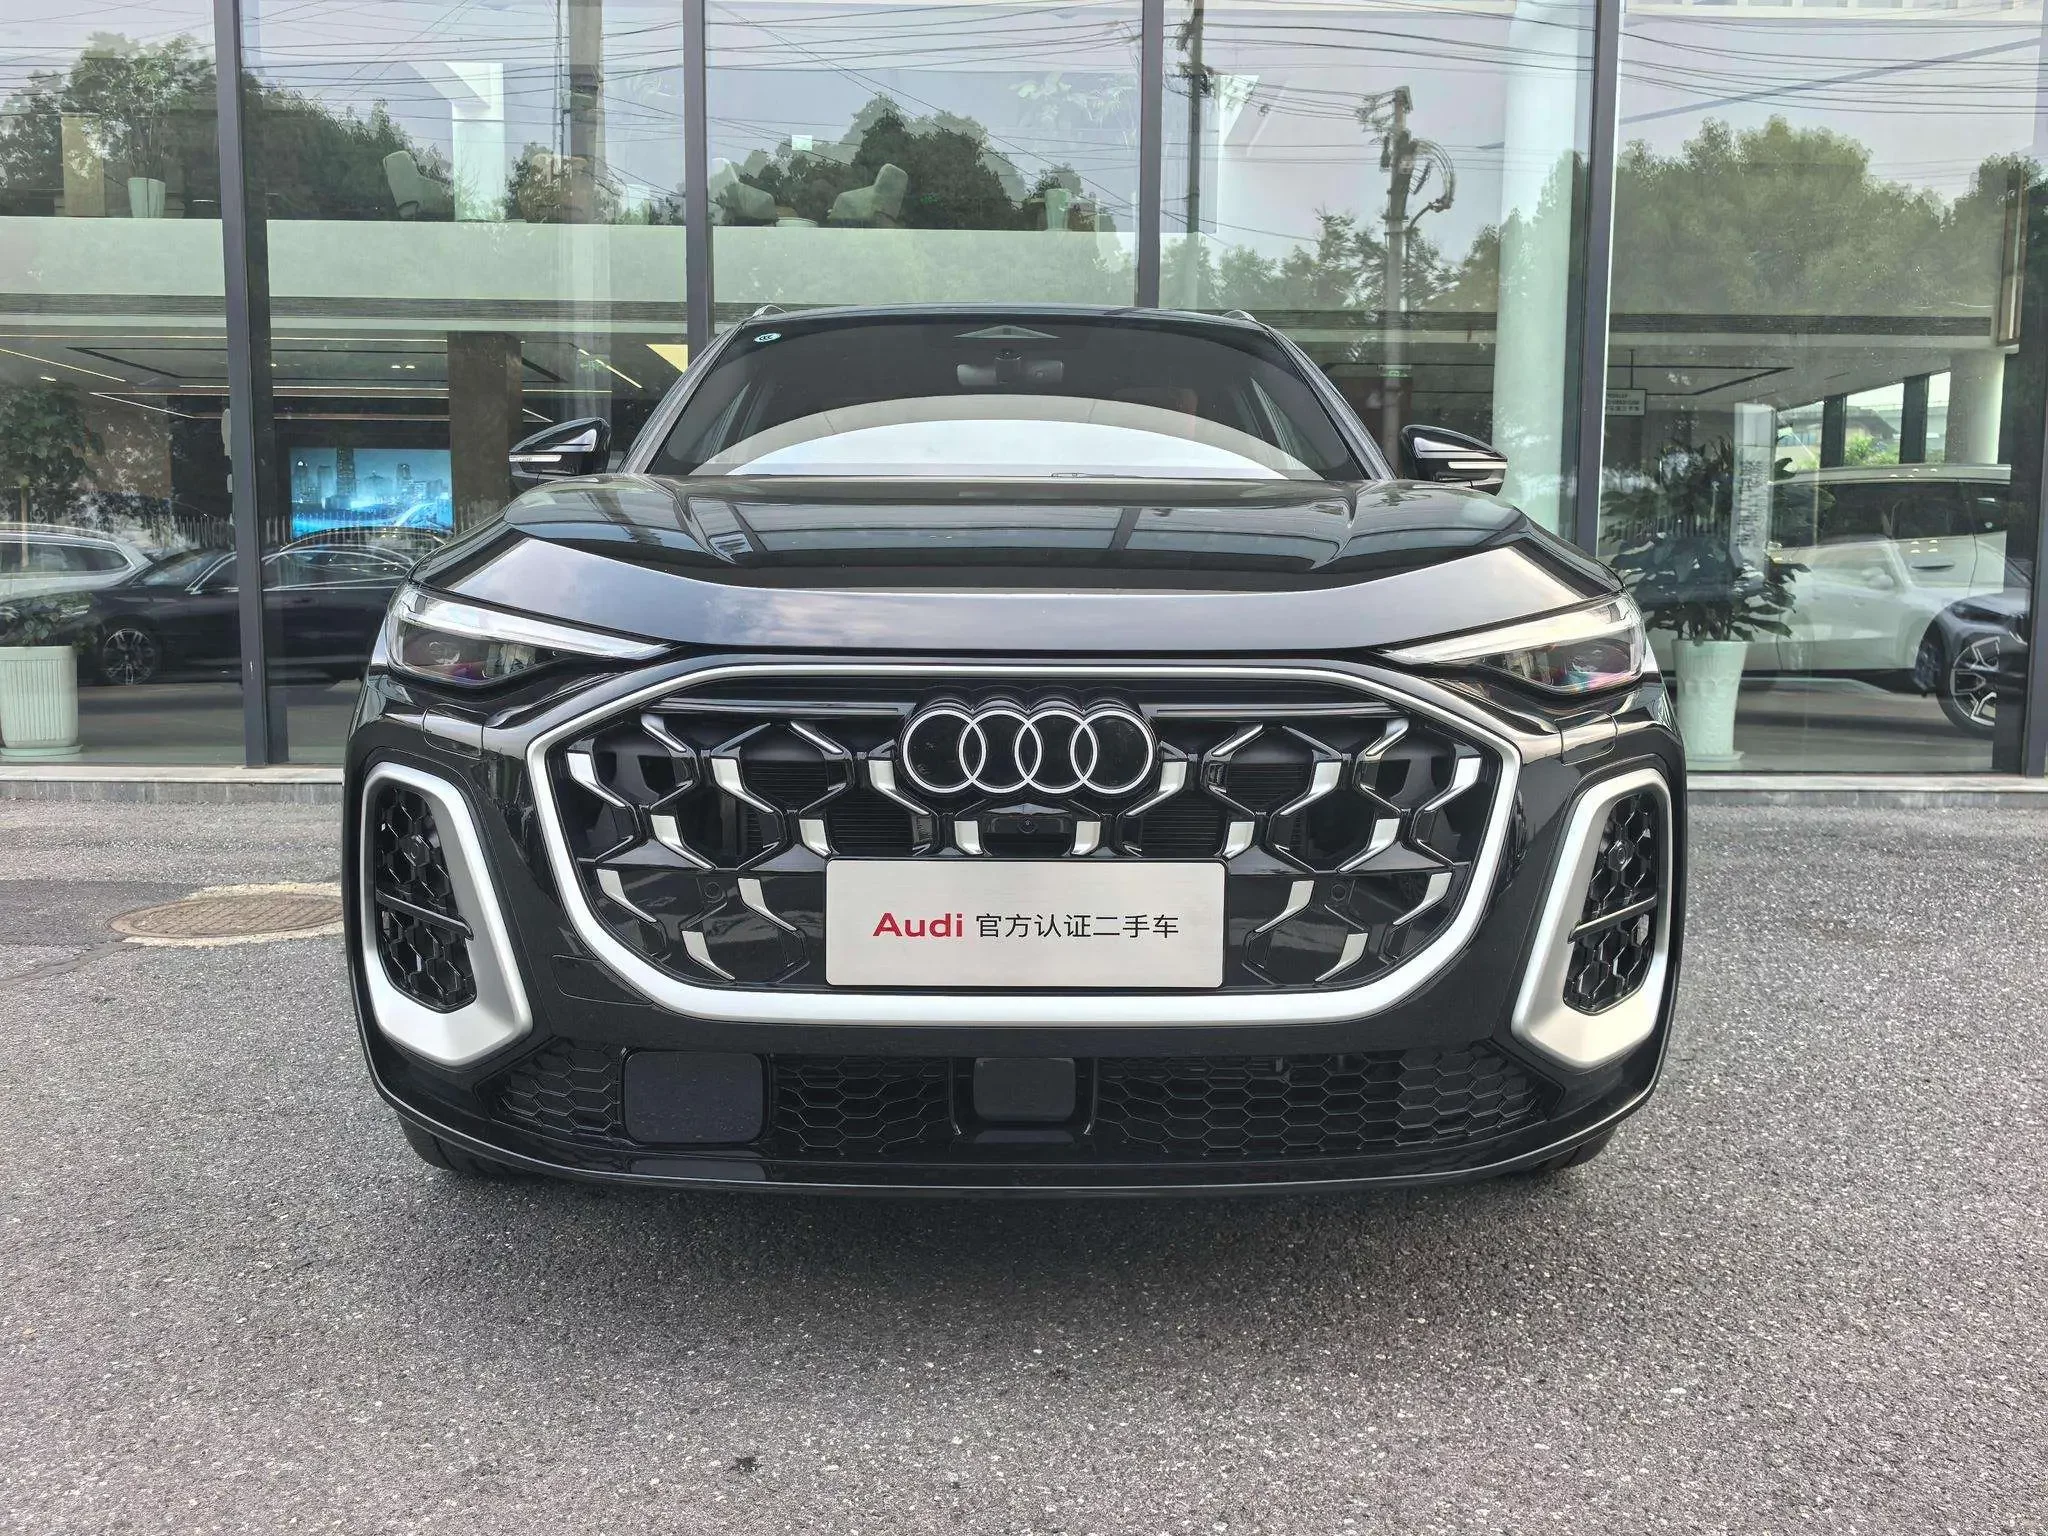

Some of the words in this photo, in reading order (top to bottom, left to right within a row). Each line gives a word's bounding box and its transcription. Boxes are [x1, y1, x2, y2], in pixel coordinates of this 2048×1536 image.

[873, 912, 963, 938] Audi
[975, 913, 1179, 939] 官方认证二手车
